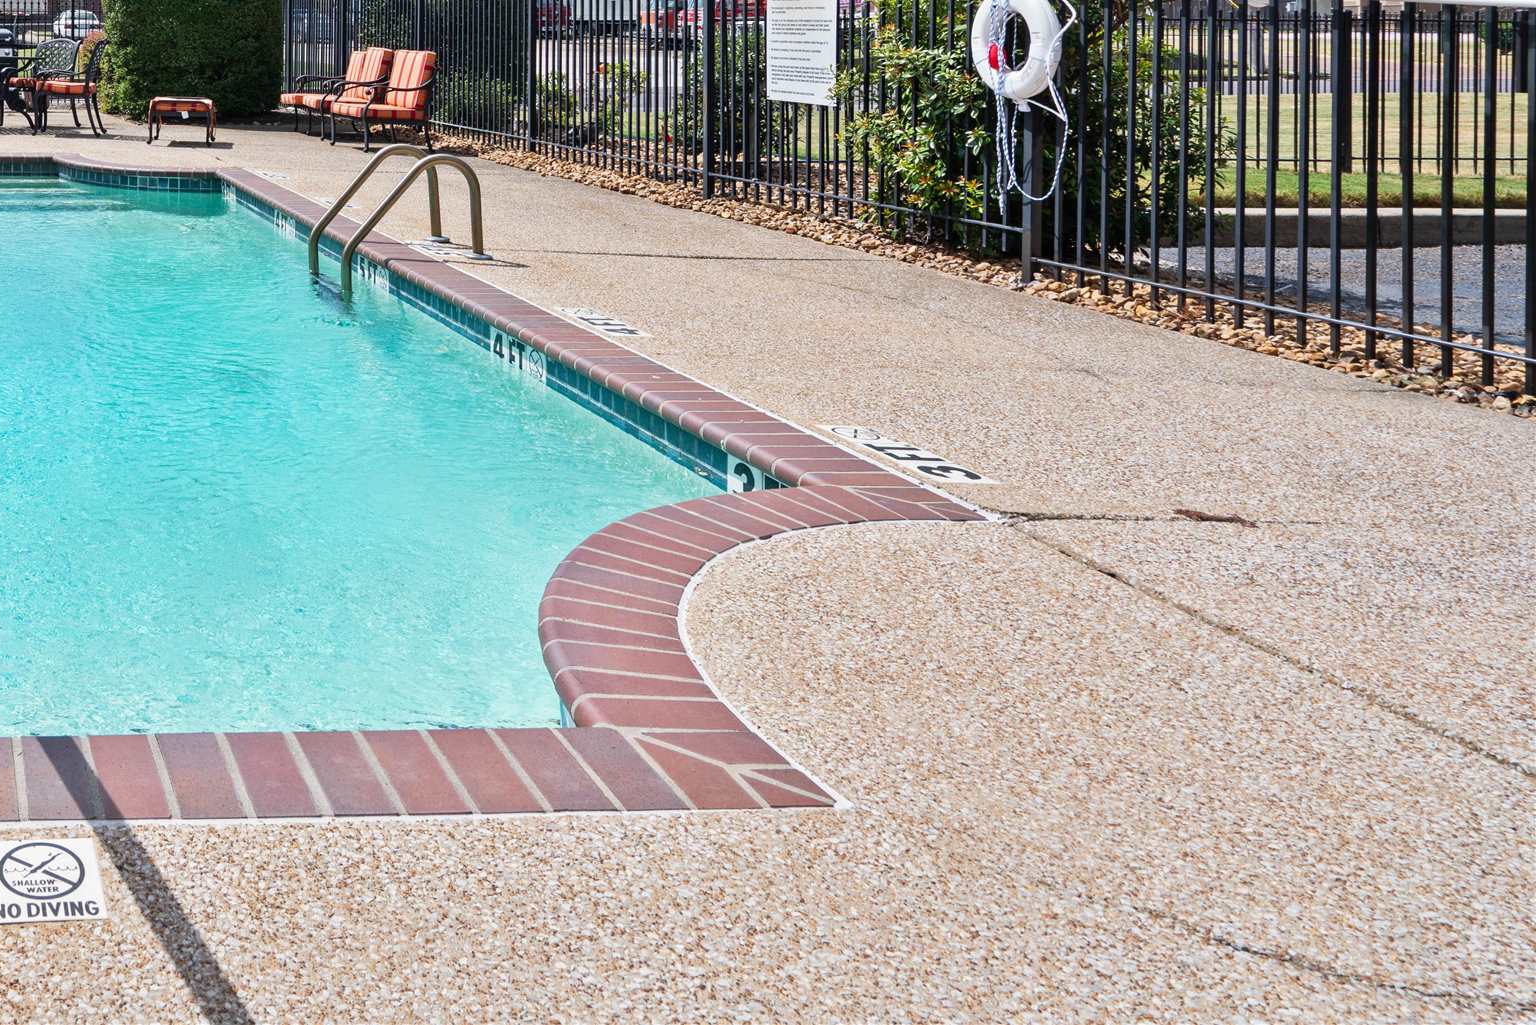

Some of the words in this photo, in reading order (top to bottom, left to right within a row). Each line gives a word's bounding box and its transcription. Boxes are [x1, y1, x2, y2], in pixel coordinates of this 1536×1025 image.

[492, 332, 505, 359] 4
[509, 338, 526, 370] FT
[916, 464, 982, 481] 3
[11, 879, 56, 887] SHALLOW
[26, 886, 60, 894] WATER
[26, 900, 100, 918] DIVING
